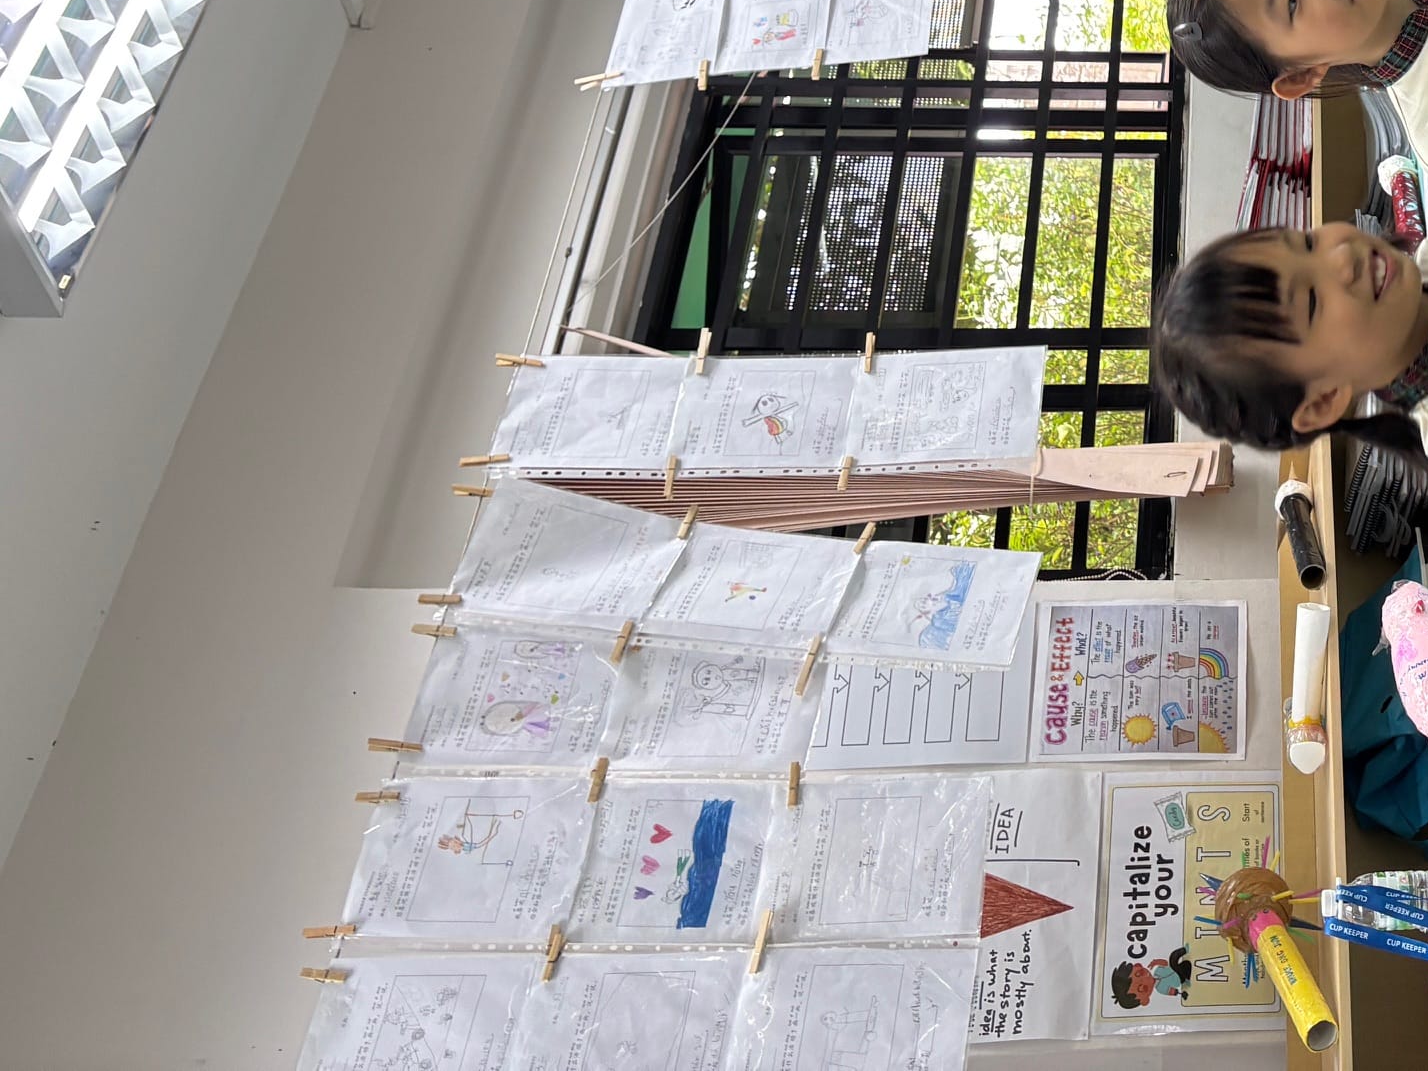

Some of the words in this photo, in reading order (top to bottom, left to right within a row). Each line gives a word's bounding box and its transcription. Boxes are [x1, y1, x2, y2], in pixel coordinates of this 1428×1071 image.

[1050, 617, 1074, 672] Effect
[1074, 631, 1088, 656] What?
[1090, 653, 1100, 664] The
[1044, 683, 1070, 745] Cause
[1070, 701, 1087, 726] Why?
[1085, 729, 1096, 743] The
[1242, 803, 1250, 822] Start
[995, 807, 1015, 854] IDEA
[1241, 837, 1250, 846] of
[1123, 825, 1156, 959] capitalize
[1154, 853, 1179, 917] your
[1354, 894, 1368, 903] CUP
[1385, 903, 1410, 915] KEEPER
[1410, 911, 1424, 920] CUP
[1329, 923, 1346, 933] CUP
[1346, 927, 1368, 939] KEEPER
[1004, 951, 1015, 963] is
[1386, 939, 1402, 947] CUP
[1402, 942, 1427, 953] KEEPER
[987, 949, 998, 985] what
[983, 991, 996, 1003] is
[1000, 968, 1020, 1009] story
[1012, 981, 1034, 1035] mostly
[979, 1009, 993, 1036] idea
[994, 1013, 1007, 1037] the
